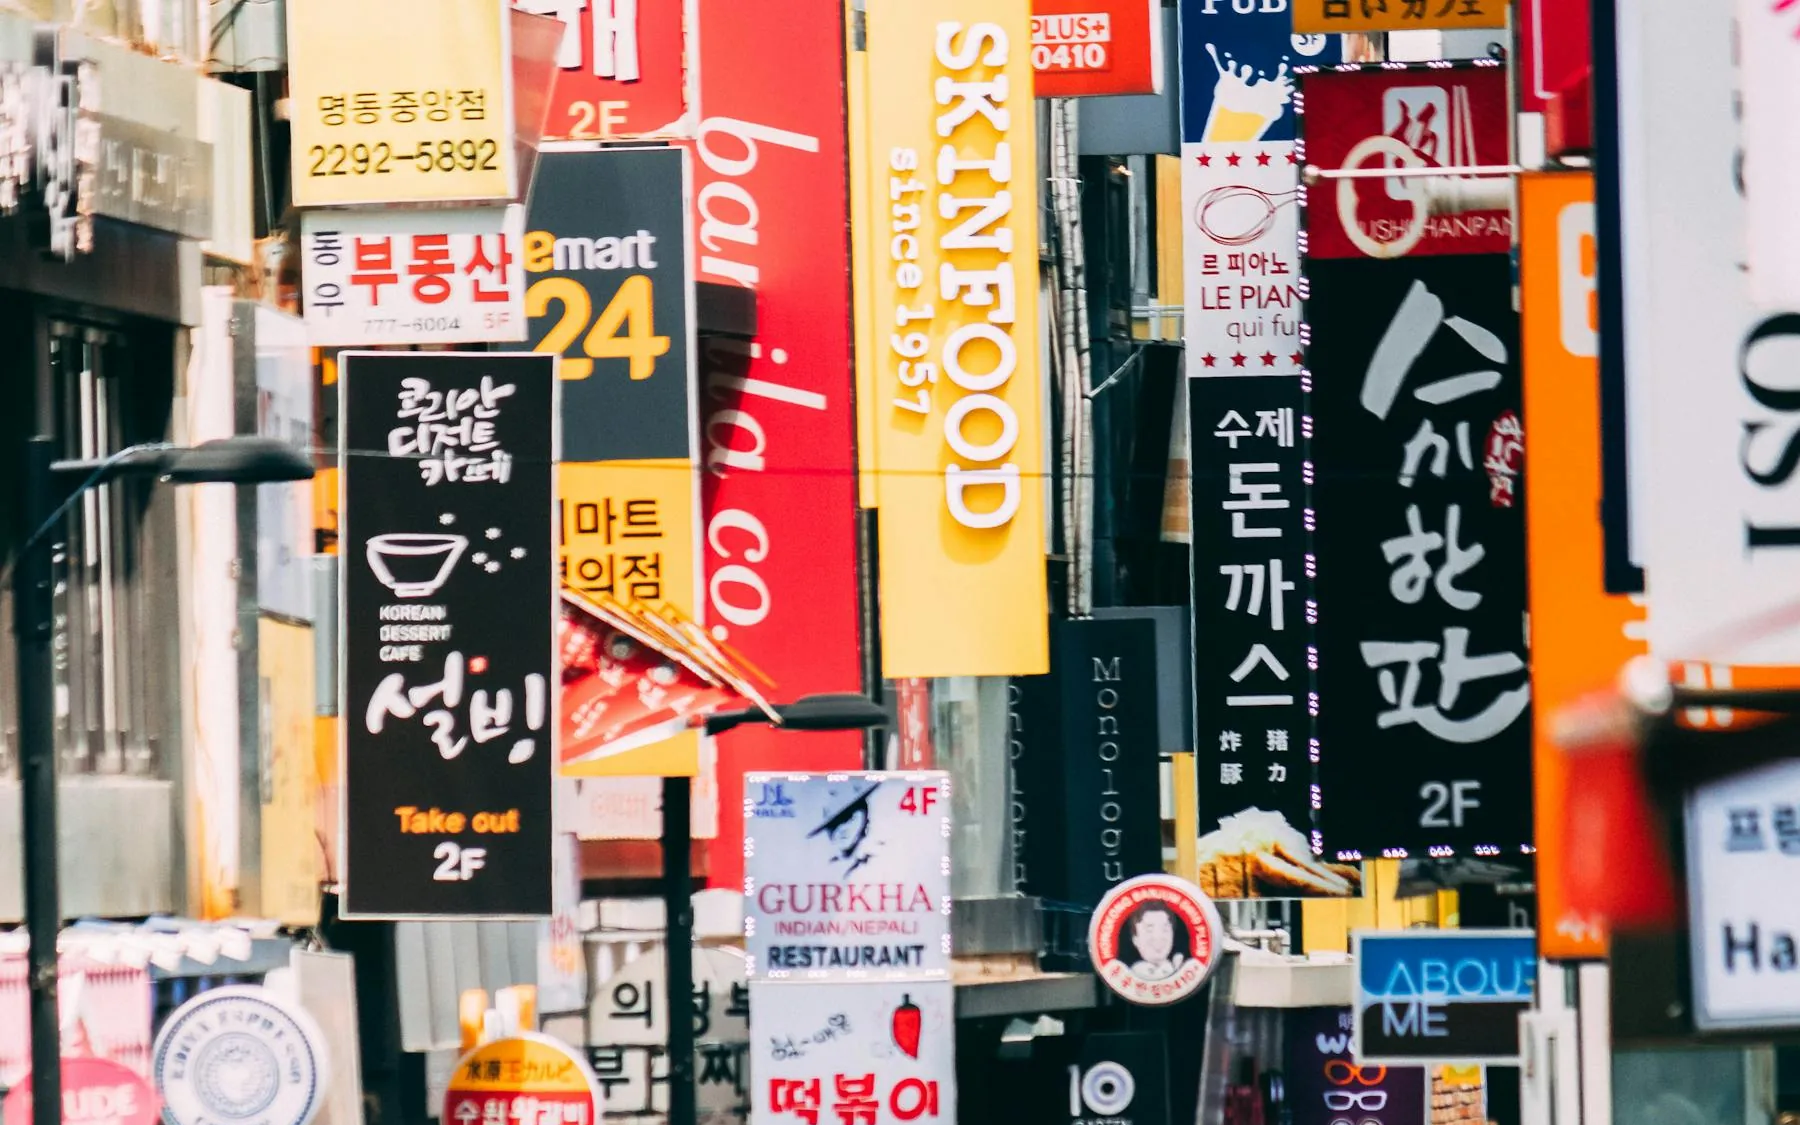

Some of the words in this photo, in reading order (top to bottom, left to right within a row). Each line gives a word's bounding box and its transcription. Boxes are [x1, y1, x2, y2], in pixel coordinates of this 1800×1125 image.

[1031, 16, 1110, 41] PLUS+
[1031, 43, 1107, 71] 0410
[566, 100, 630, 139] 2F
[308, 138, 499, 178] 2292-5892
[890, 146, 927, 290] since
[348, 232, 513, 307] 부동산
[523, 229, 658, 273] emart
[936, 21, 1021, 529] SKINFOOD
[1200, 285, 1231, 311] LE
[524, 274, 671, 381] 24
[1226, 315, 1264, 344] qui
[1272, 314, 1302, 338] fu
[890, 303, 938, 415] 1957
[396, 374, 518, 423] 코리안
[387, 415, 501, 457] 디저트
[1213, 407, 1295, 449] 수제
[418, 446, 513, 487] 카페
[560, 497, 663, 546] 마트
[560, 552, 661, 599] 의점
[1219, 462, 1297, 707] 돈까스
[379, 604, 448, 622] KOREAN
[379, 624, 454, 642] DESSERT
[393, 805, 467, 834] Take
[471, 808, 521, 834] out
[898, 786, 938, 816] 4F
[1419, 780, 1482, 828] 2F
[432, 841, 488, 881] 2F
[757, 882, 936, 915] GURKHA
[767, 945, 925, 969] RESTAURANT
[1382, 1001, 1449, 1038] ME
